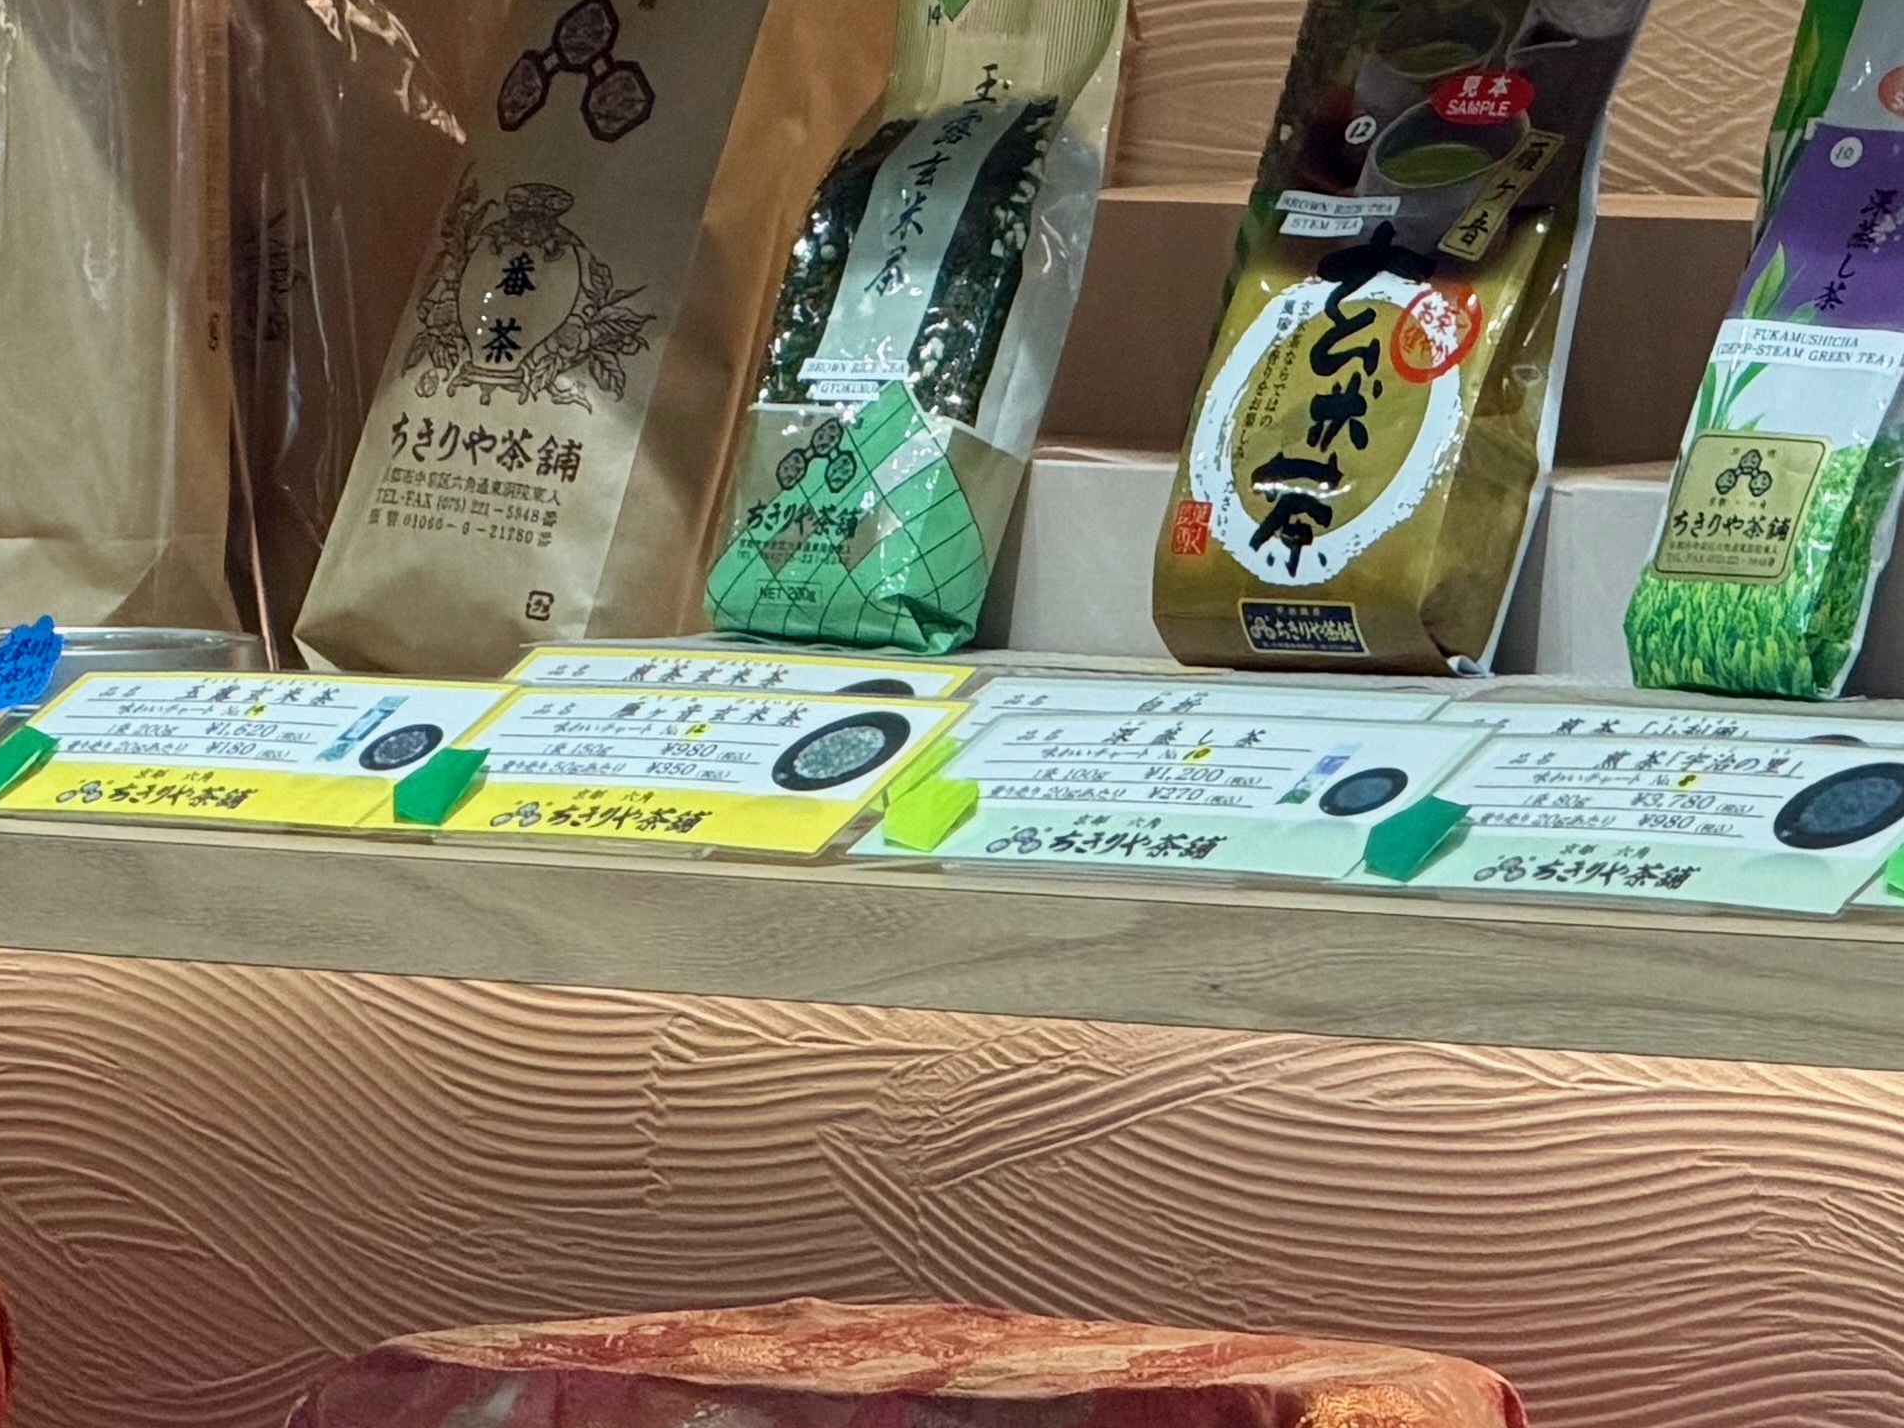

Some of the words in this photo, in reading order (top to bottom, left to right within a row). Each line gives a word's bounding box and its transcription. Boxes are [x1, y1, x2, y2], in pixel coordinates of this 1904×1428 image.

[1458, 75, 1511, 97] 見本
[1446, 100, 1511, 117] SAMPLE
[482, 252, 538, 366] 番茶
[1753, 328, 1860, 348] FUKAMUSHICHA
[1808, 349, 1854, 362] GREEN
[392, 412, 583, 483] ちきりや茶舗
[1671, 509, 1792, 542] ちきりや茶舗
[1629, 790, 1716, 811] ¥3,780
[1637, 810, 1694, 830] ¥980
[1049, 829, 1229, 860] ちきりや茶舗
[1533, 857, 1703, 890] ちきりや茶舗
